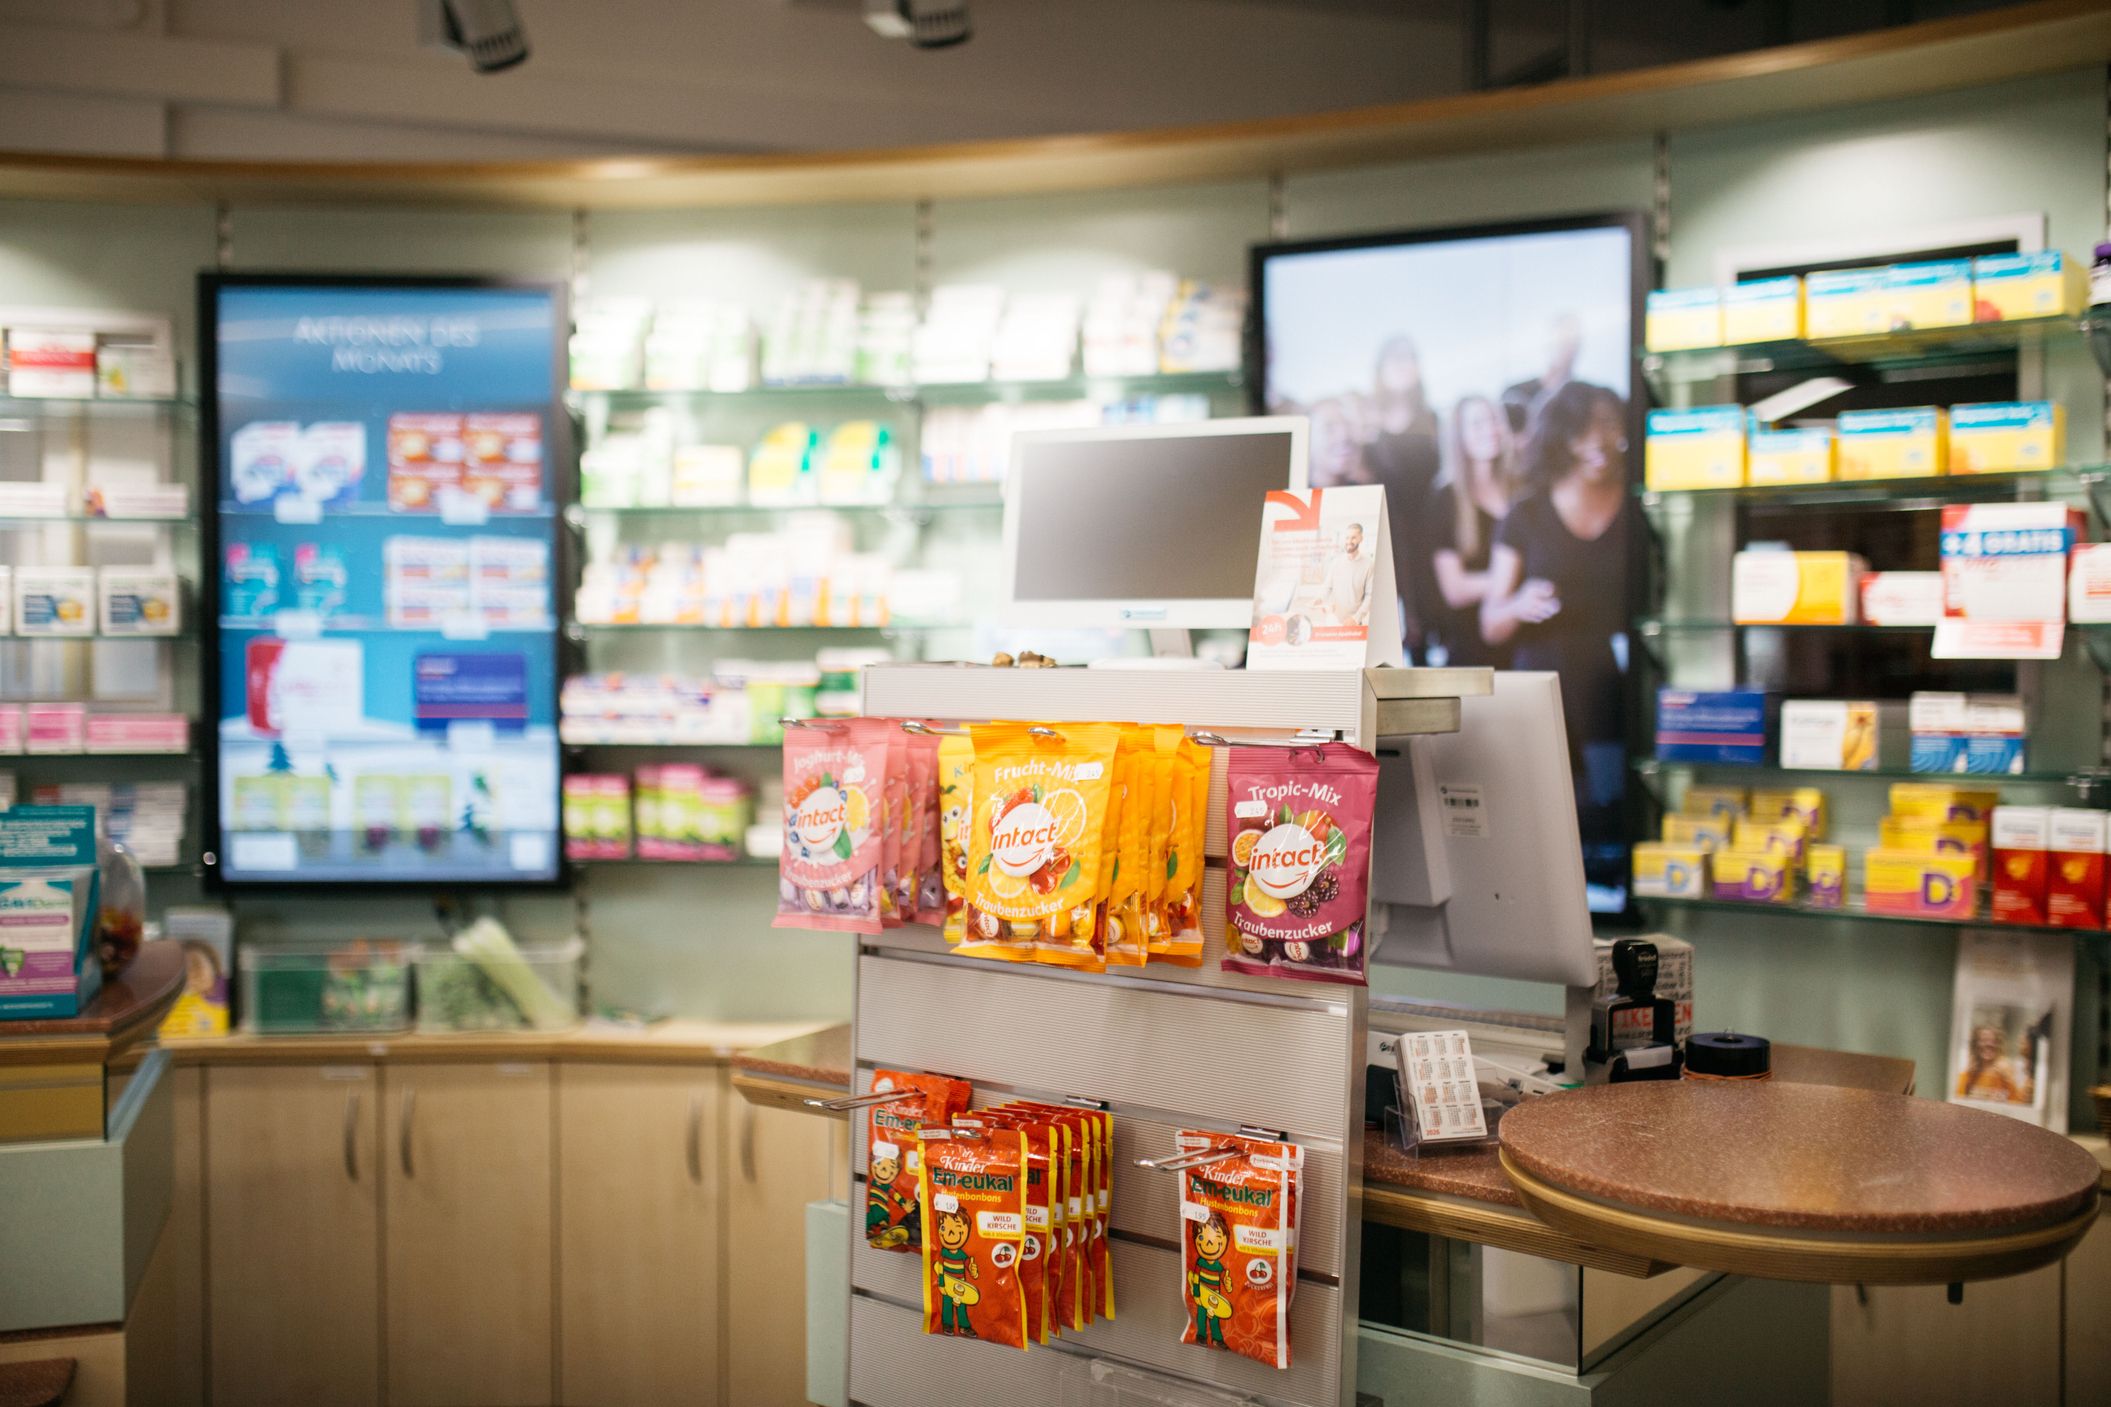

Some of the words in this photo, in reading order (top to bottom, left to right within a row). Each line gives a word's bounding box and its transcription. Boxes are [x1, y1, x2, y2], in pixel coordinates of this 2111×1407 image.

[1983, 529, 2063, 554] GRATIS
[1247, 780, 1342, 806] Tropic-Mix
[797, 803, 845, 829] intact
[992, 822, 1057, 851] intact
[1250, 844, 1320, 871] intact
[975, 890, 1064, 918] Traubenzucker
[1234, 911, 1332, 939] Traubenzucker
[940, 1155, 987, 1174] Kinder
[1199, 1164, 1246, 1186] Kinder
[933, 1167, 1014, 1192] Em-eukal
[1192, 1175, 1272, 1208] Em-eukal
[1200, 1197, 1259, 1217] Hustenbonbons
[987, 1222, 1017, 1231] KIRSCHE
[1248, 1229, 1267, 1238] WILD
